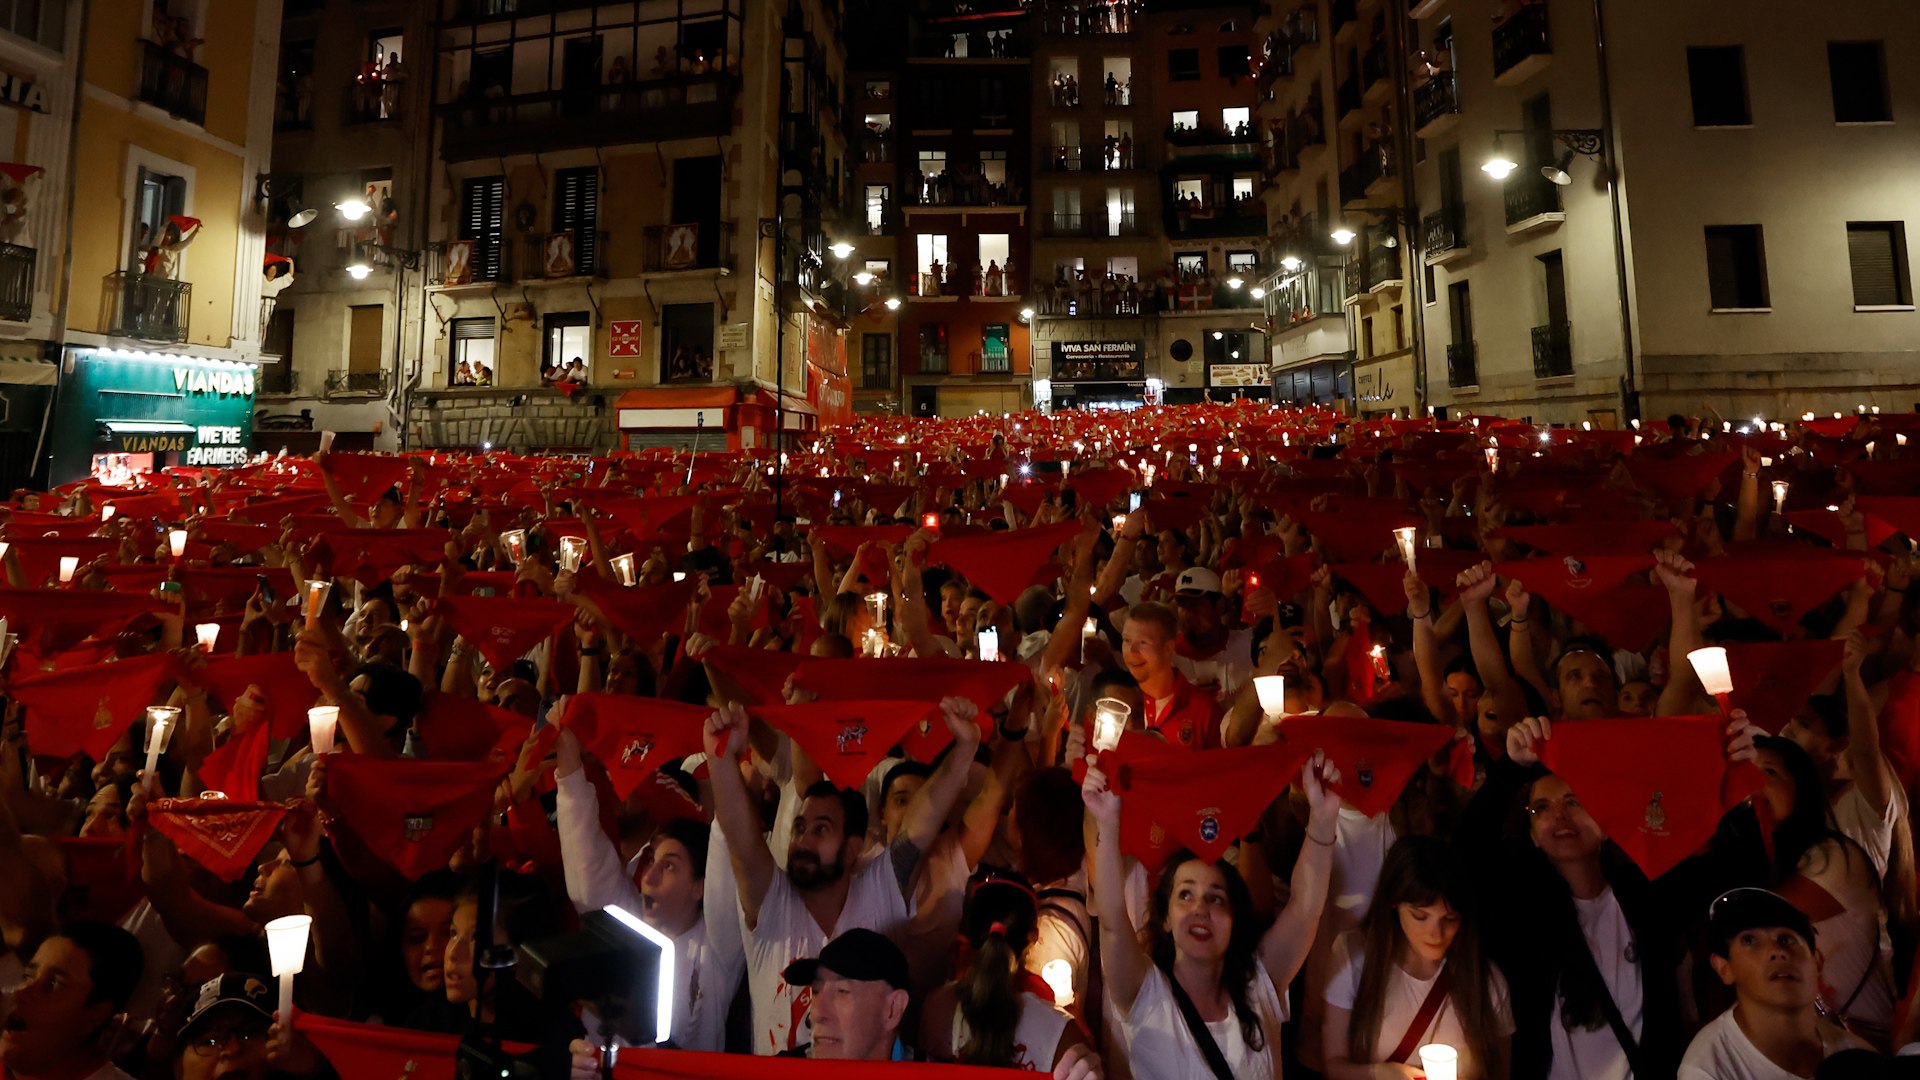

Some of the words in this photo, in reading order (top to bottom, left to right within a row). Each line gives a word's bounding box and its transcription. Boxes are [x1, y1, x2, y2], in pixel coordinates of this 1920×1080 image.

[1083, 344, 1101, 352] SAN
[172, 367, 254, 395] VIANDAS
[920, 402, 927, 411] 6
[122, 435, 186, 452] VIANDAS
[198, 426, 241, 444] WE'RE
